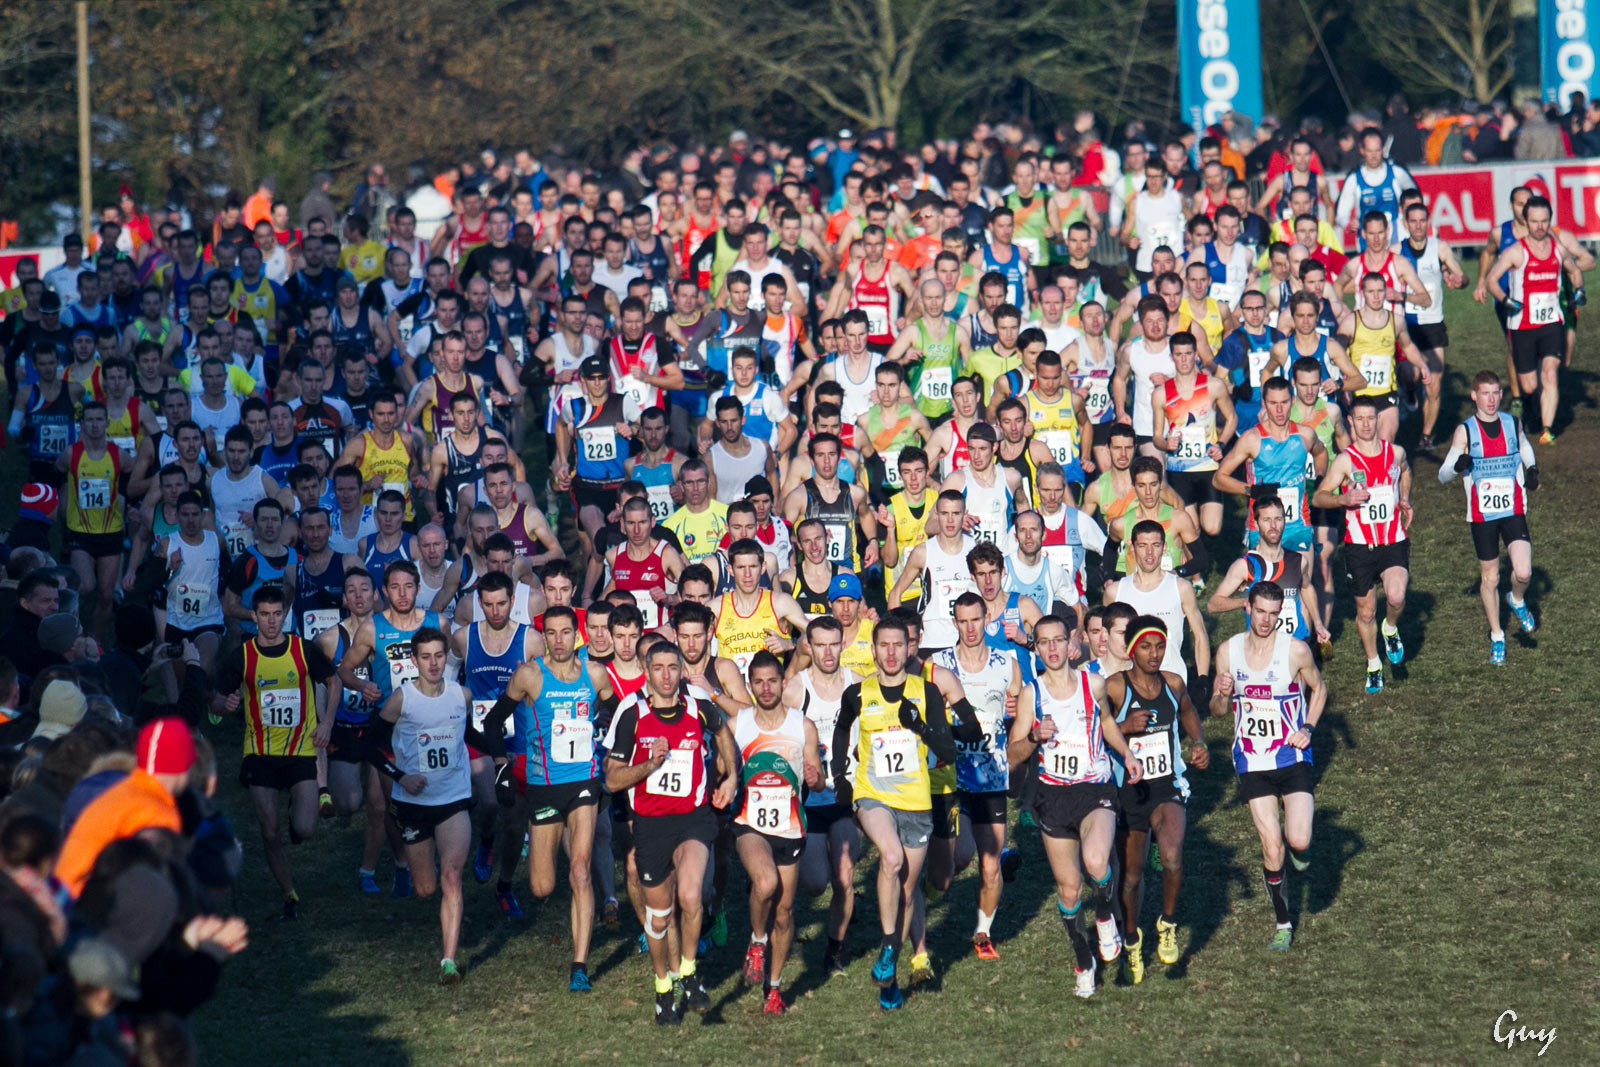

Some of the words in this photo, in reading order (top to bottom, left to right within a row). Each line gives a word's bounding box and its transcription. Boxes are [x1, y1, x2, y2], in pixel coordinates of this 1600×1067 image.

[1560, 173, 1600, 228] T
[1534, 307, 1554, 321] 182
[927, 383, 948, 396] 160
[42, 437, 66, 452] 240
[588, 443, 613, 459] 229
[1177, 443, 1202, 458] 253
[85, 492, 104, 507] 114
[1483, 495, 1510, 510] 206
[1368, 504, 1387, 520] 60
[183, 598, 201, 615] 64
[269, 707, 294, 726] 113
[1247, 717, 1276, 737] 291
[427, 747, 449, 769] 66
[568, 740, 575, 760] 1
[885, 752, 905, 773] 12
[1053, 753, 1079, 775] 119
[658, 772, 681, 793] 45
[757, 807, 780, 828] 83
